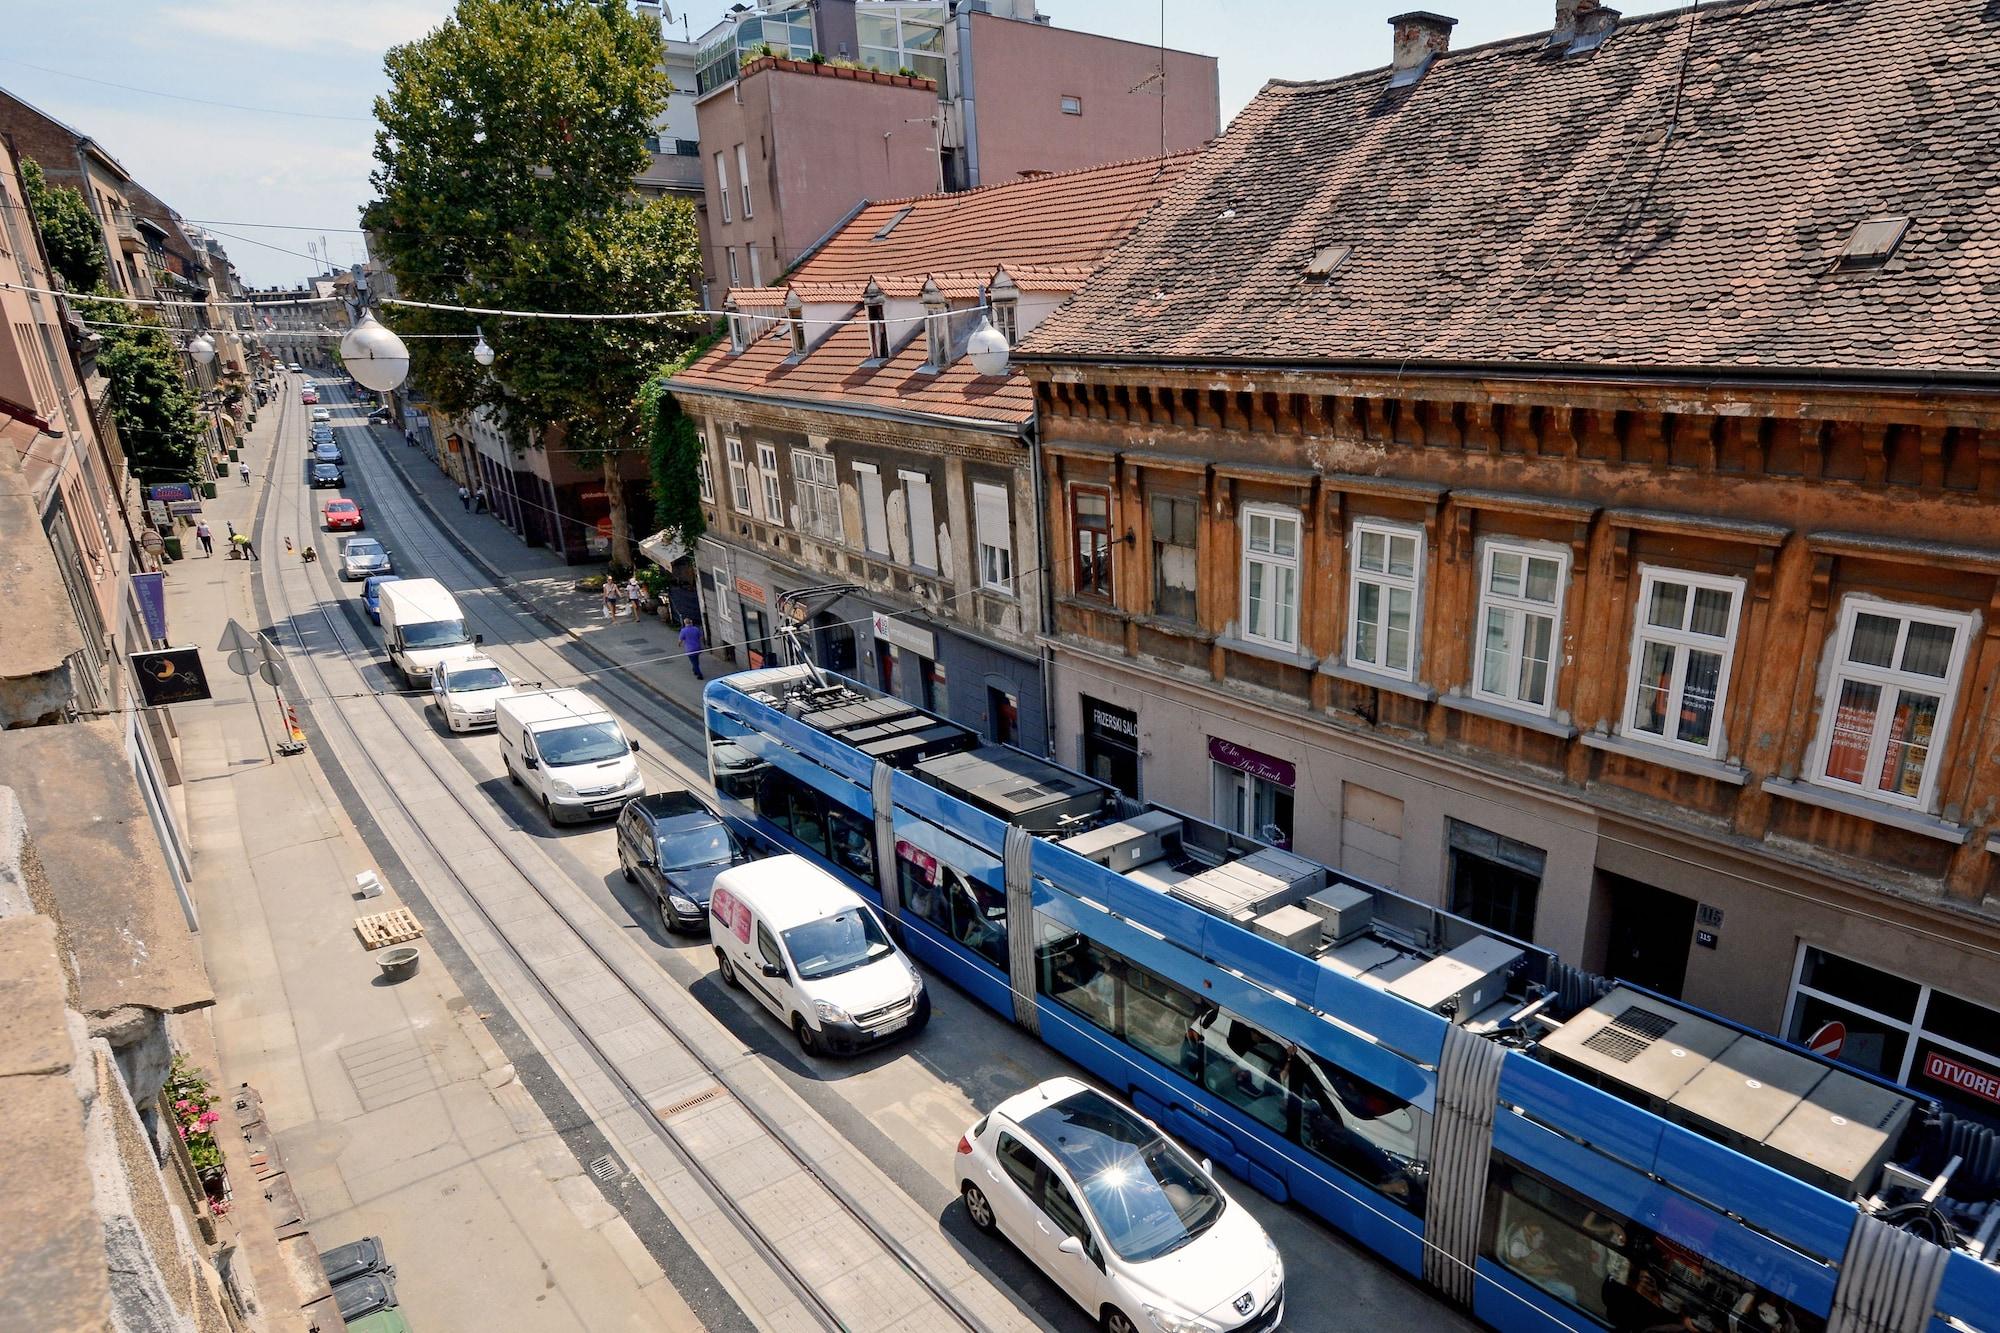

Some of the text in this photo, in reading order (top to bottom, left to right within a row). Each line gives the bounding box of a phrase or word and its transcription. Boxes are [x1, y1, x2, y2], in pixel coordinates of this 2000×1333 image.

[1093, 709, 1122, 732] FRIZERSKI
[1233, 758, 1281, 781] Art Touch
[1700, 932, 1712, 942] 115
